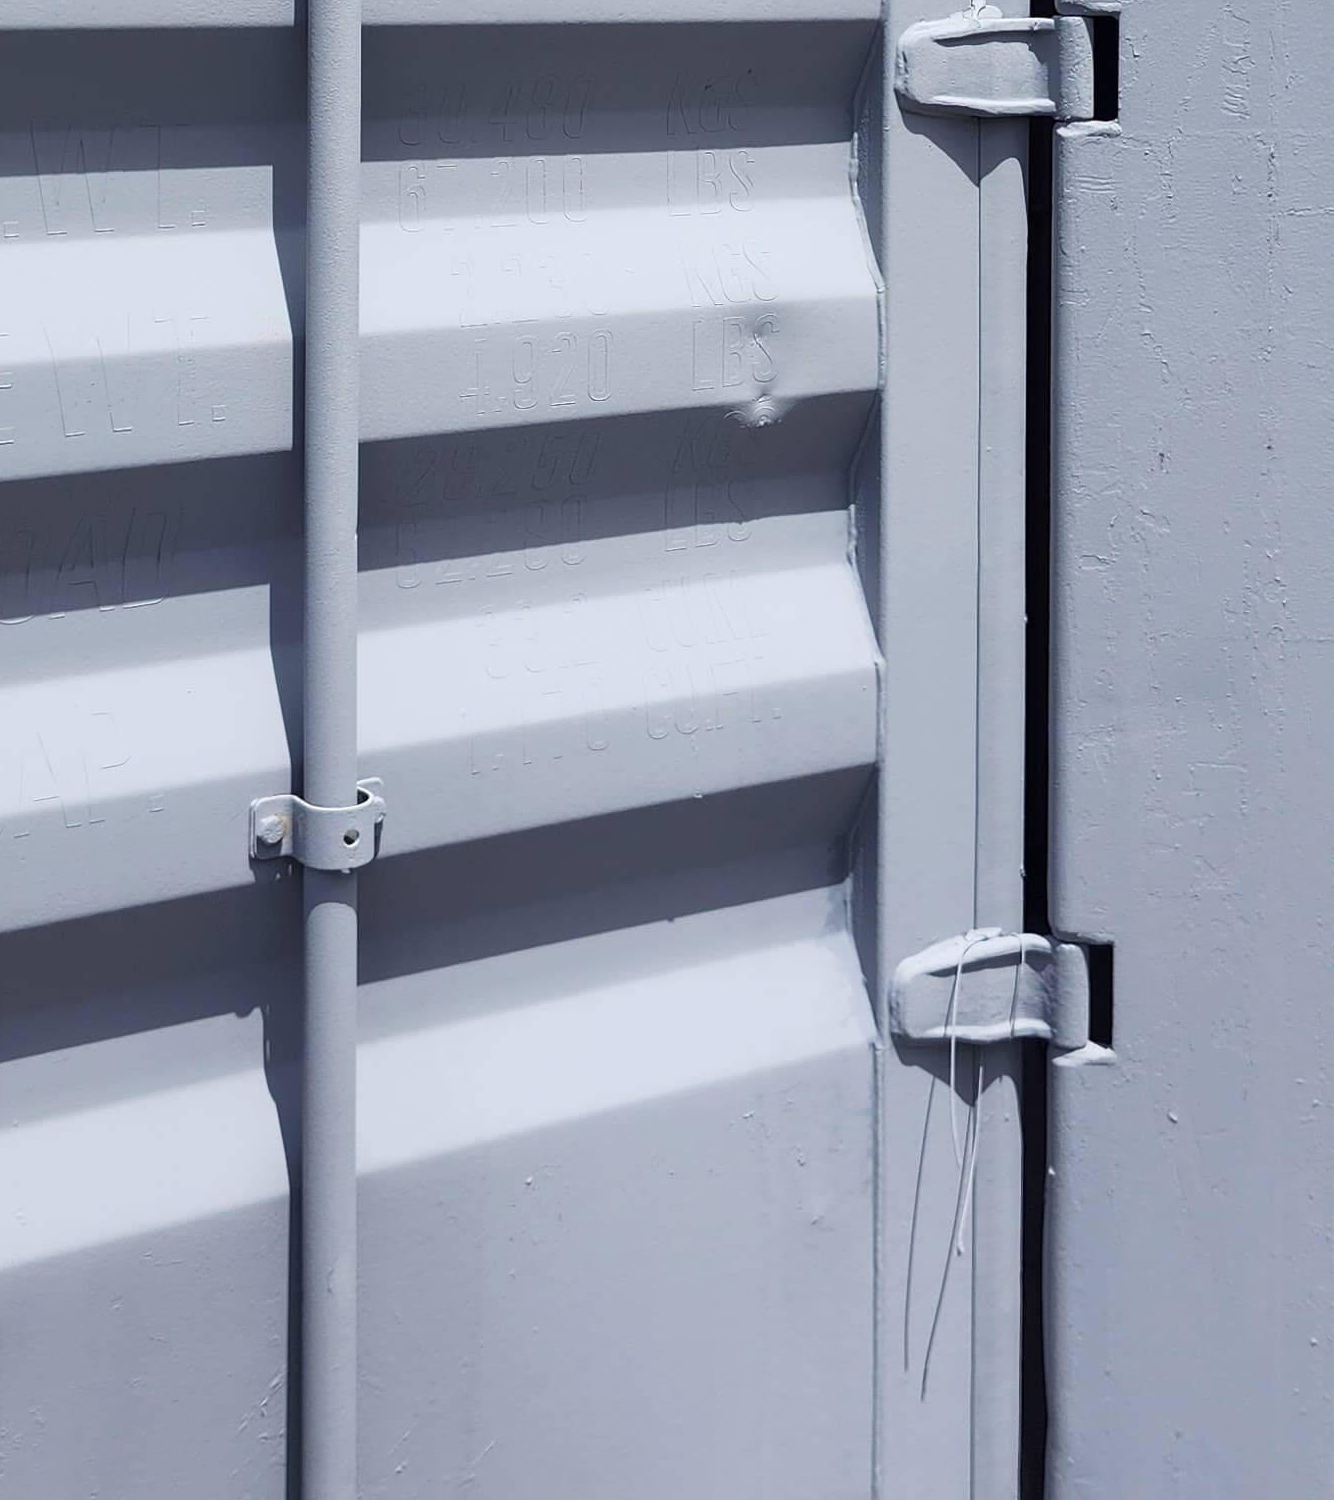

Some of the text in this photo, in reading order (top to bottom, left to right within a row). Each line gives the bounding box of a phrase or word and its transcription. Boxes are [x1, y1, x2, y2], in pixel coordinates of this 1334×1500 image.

[666, 147, 756, 217] LBS
[691, 312, 781, 393] LBS
[664, 478, 752, 552] LBS
